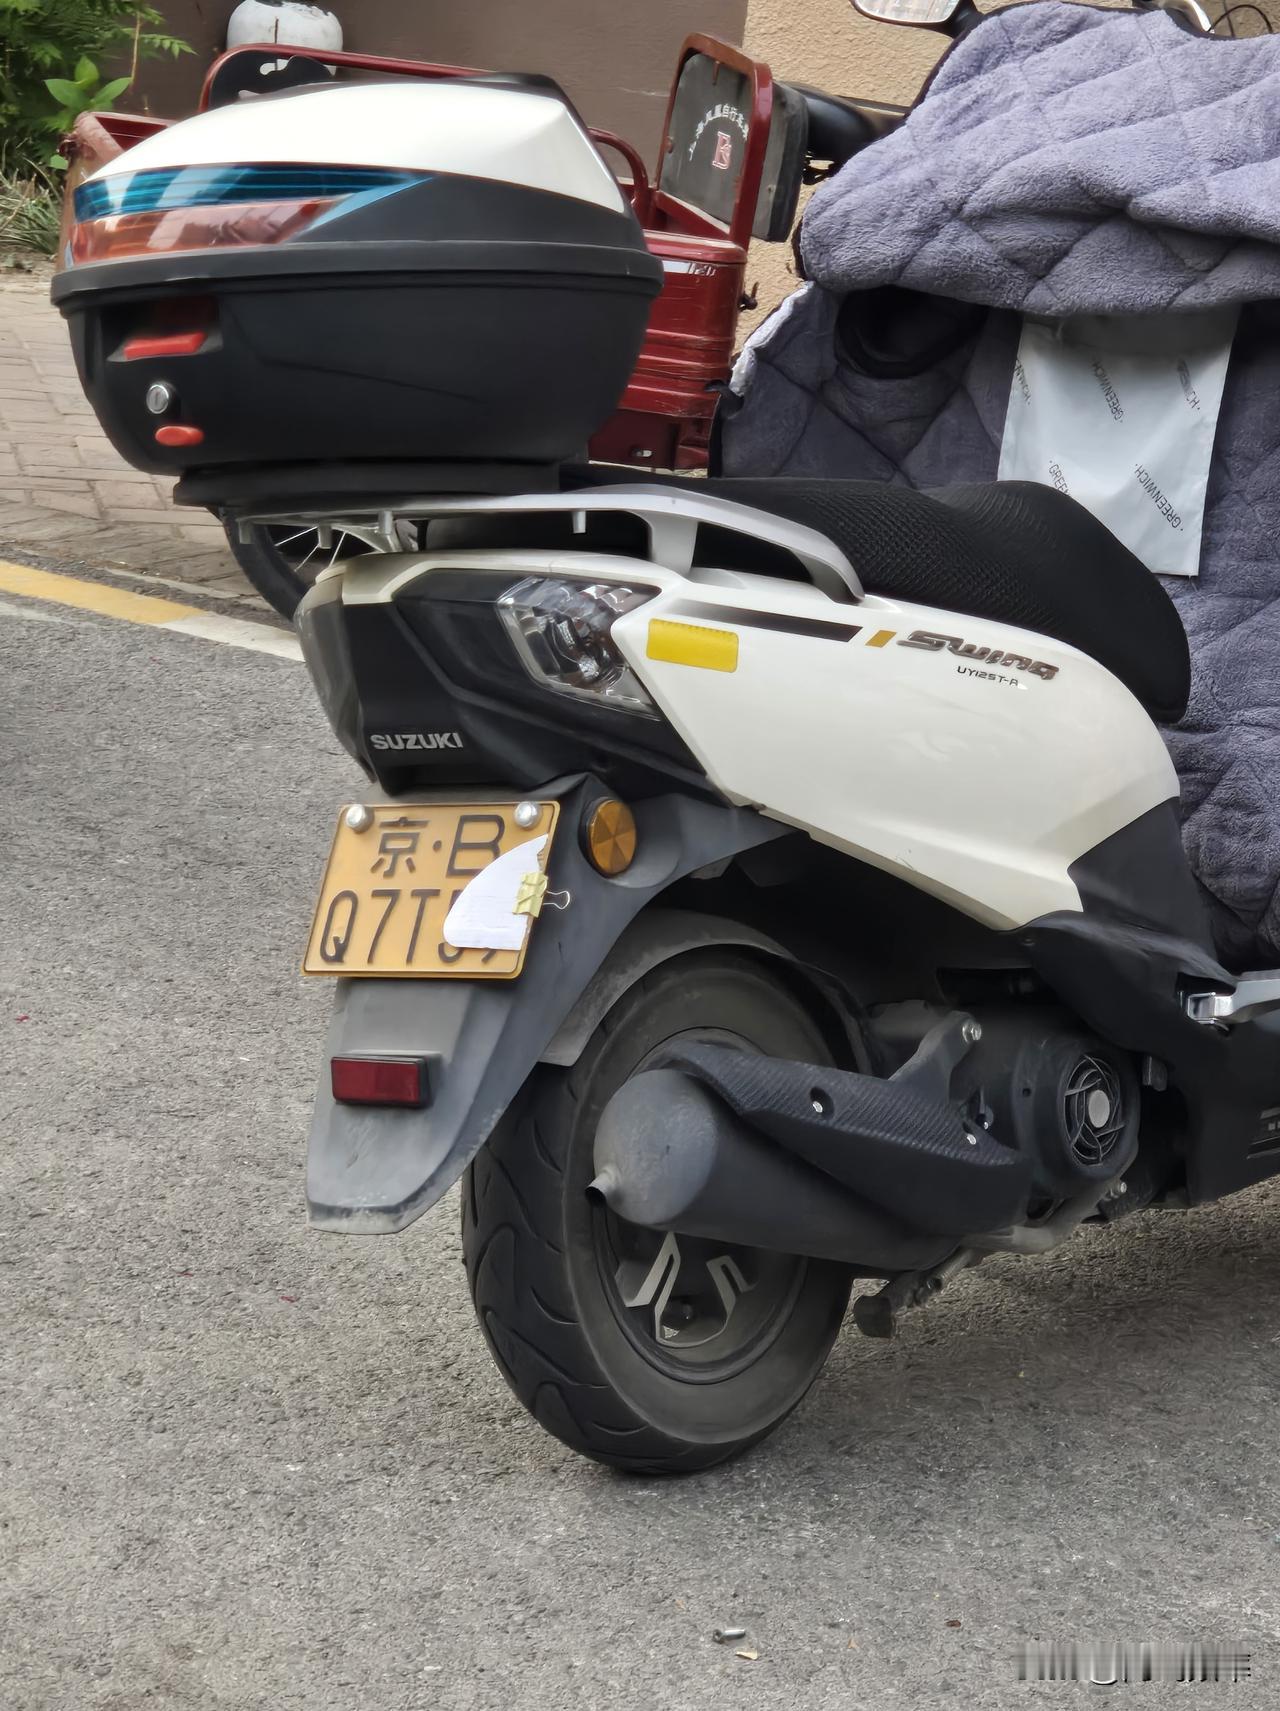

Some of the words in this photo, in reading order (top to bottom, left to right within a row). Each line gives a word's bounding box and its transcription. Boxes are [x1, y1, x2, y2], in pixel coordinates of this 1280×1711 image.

[1092, 360, 1124, 420] GREENWICH
[1134, 464, 1182, 529] GREENWICH
[370, 732, 464, 750] SUZUKI
[319, 888, 501, 964] Q7T
